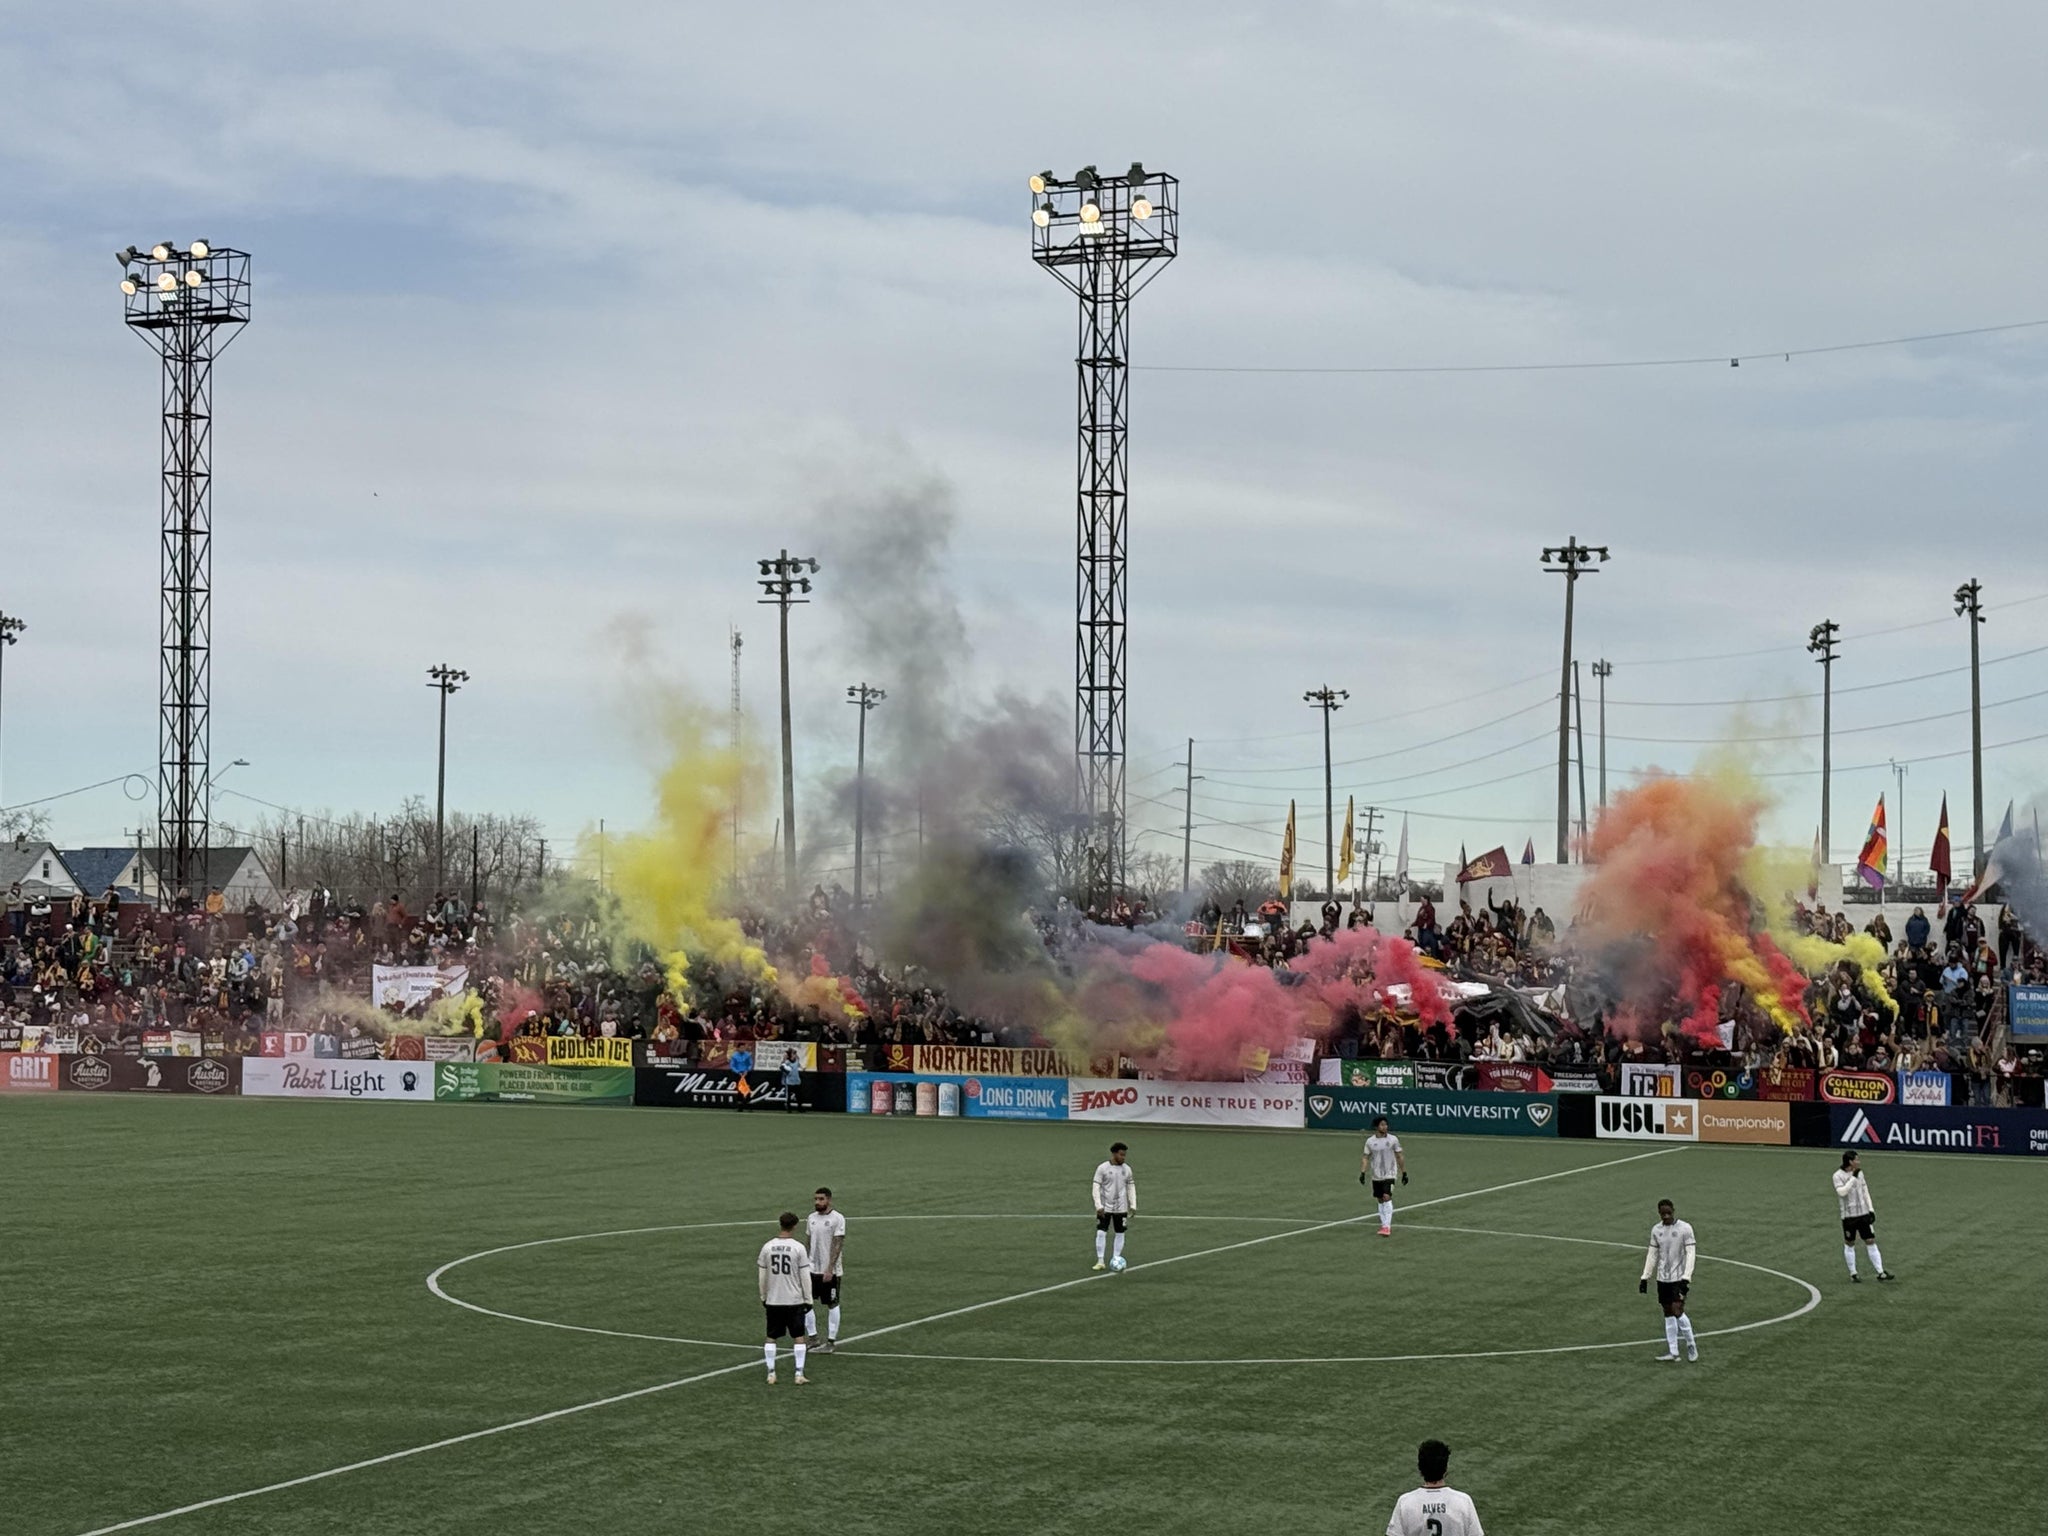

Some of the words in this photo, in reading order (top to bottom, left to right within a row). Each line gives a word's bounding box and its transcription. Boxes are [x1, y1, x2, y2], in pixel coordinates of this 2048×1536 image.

[264, 1036, 278, 1053] F
[290, 1035, 307, 1053] D
[551, 1038, 604, 1060] ABOLISH
[607, 1038, 630, 1062] ICE
[10, 1056, 51, 1079] GRIT
[919, 1045, 1014, 1076] NORTHERN
[1020, 1049, 1077, 1079] GUAR
[1417, 1065, 1446, 1075] Smoking
[74, 1065, 108, 1078] Austin
[191, 1066, 225, 1081] Austin
[282, 1063, 326, 1090] Pabst
[330, 1069, 386, 1096] Light
[499, 1069, 532, 1080] POWERED
[1376, 1076, 1403, 1085] NEEDS
[1554, 1071, 1583, 1079] FREEDOM
[499, 1080, 525, 1091] PLACED
[526, 1081, 555, 1091] AROUND
[556, 1082, 568, 1091] THE
[570, 1082, 593, 1092] GLOBE
[667, 1072, 739, 1093] Moto
[1828, 1078, 1885, 1092] COALITION
[980, 1087, 1013, 1107] LONG
[1016, 1088, 1056, 1109] DRINK
[1077, 1087, 1138, 1111] FAYGO
[1146, 1095, 1174, 1107] THE
[1181, 1096, 1211, 1108] ONE
[1219, 1097, 1257, 1110] TRUE
[1832, 1088, 1880, 1100] DETROIT
[1339, 1101, 1387, 1115] WAYNE
[1391, 1102, 1432, 1116] STATE
[1436, 1103, 1521, 1120] UNIVERSITY
[1601, 1101, 1665, 1134] USL
[1702, 1114, 1786, 1132] Championship
[1886, 1122, 2000, 1149] AlumniFi
[2029, 1129, 2048, 1141] Offi
[770, 1254, 792, 1275] 56
[1422, 1503, 1447, 1515] ALVES
